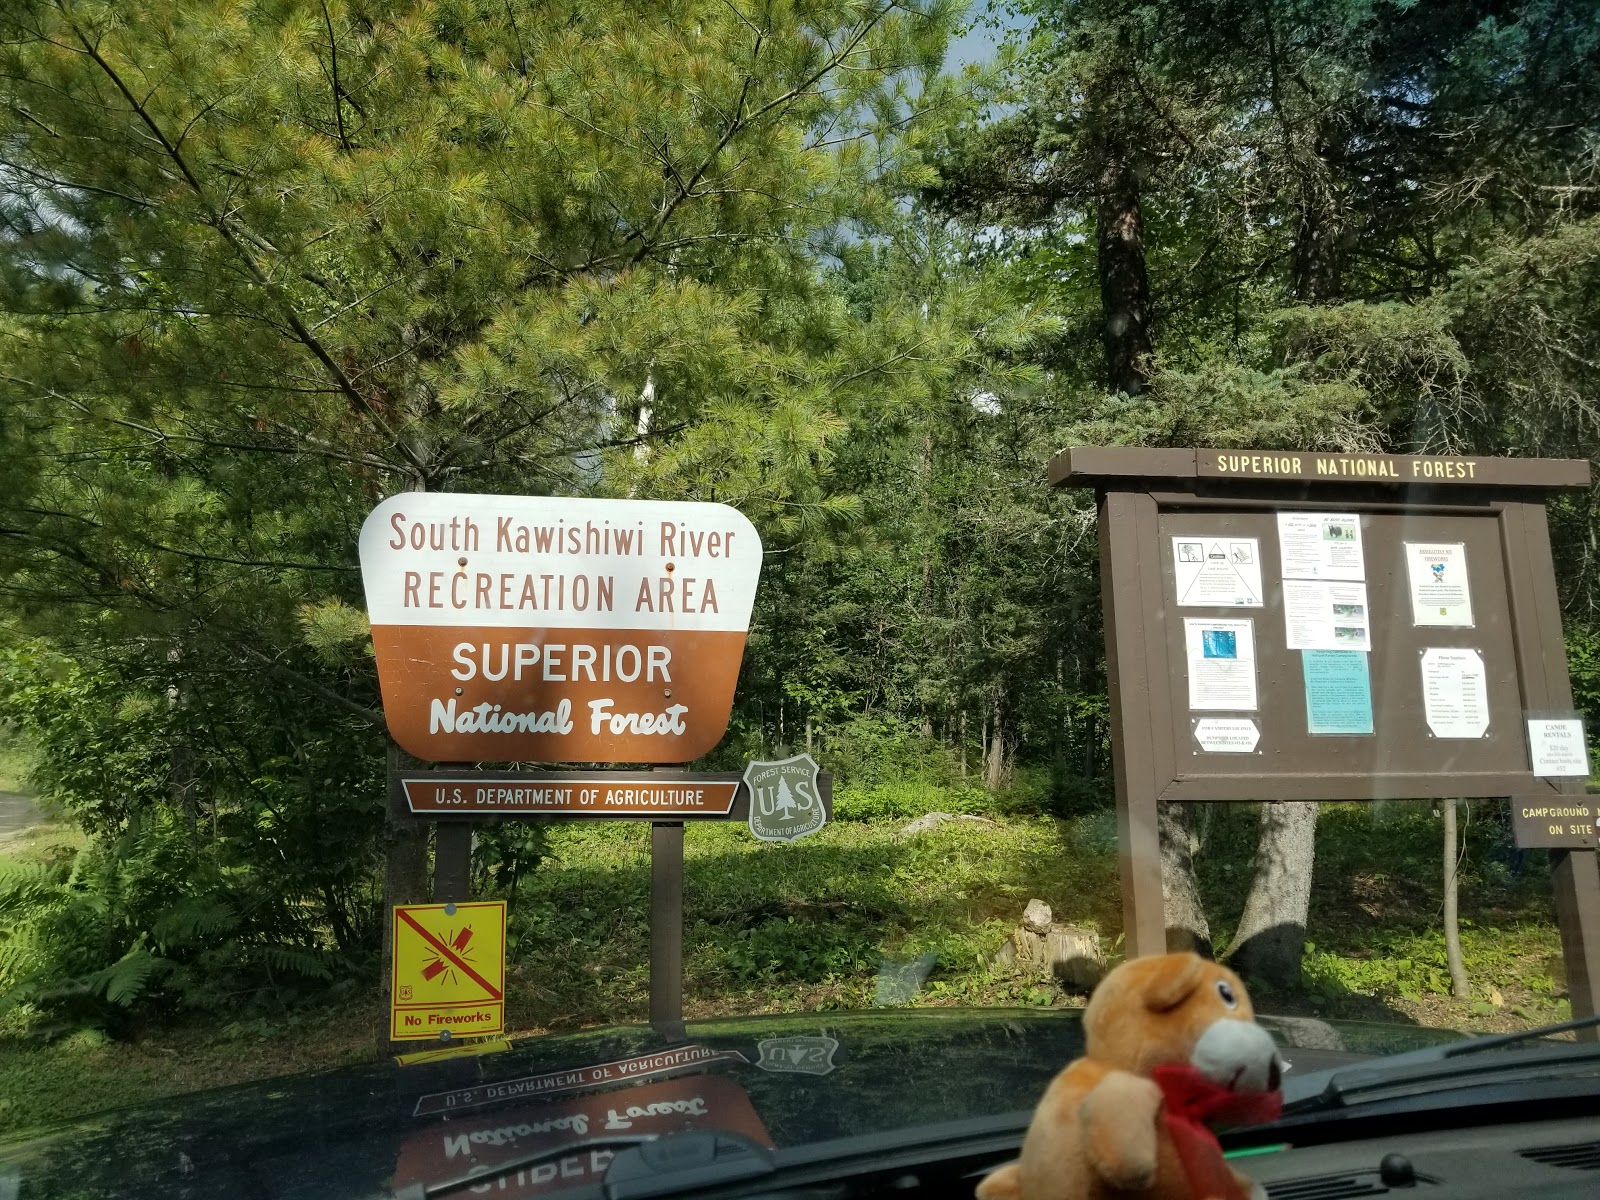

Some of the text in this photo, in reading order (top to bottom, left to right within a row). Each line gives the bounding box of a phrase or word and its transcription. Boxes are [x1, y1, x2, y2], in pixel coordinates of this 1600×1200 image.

[1217, 455, 1477, 479] SUPERIOR NATIONAL FOREST
[389, 512, 736, 559] South Kawishiwi River
[403, 571, 719, 614] RECREATION AREA
[450, 642, 672, 683] SUPERIOR
[429, 698, 689, 736] National Forest
[753, 766, 811, 786] FOREST SERVICE
[434, 788, 705, 806] U.S. DEPARTMENT OF AGRICULTURE
[754, 806, 820, 836] DEPARTMENT OF AGRICULTURE
[1522, 807, 1590, 818] CAMPGROUND
[1548, 824, 1593, 835] ON SITE
[404, 1012, 492, 1026] No Fireworks
